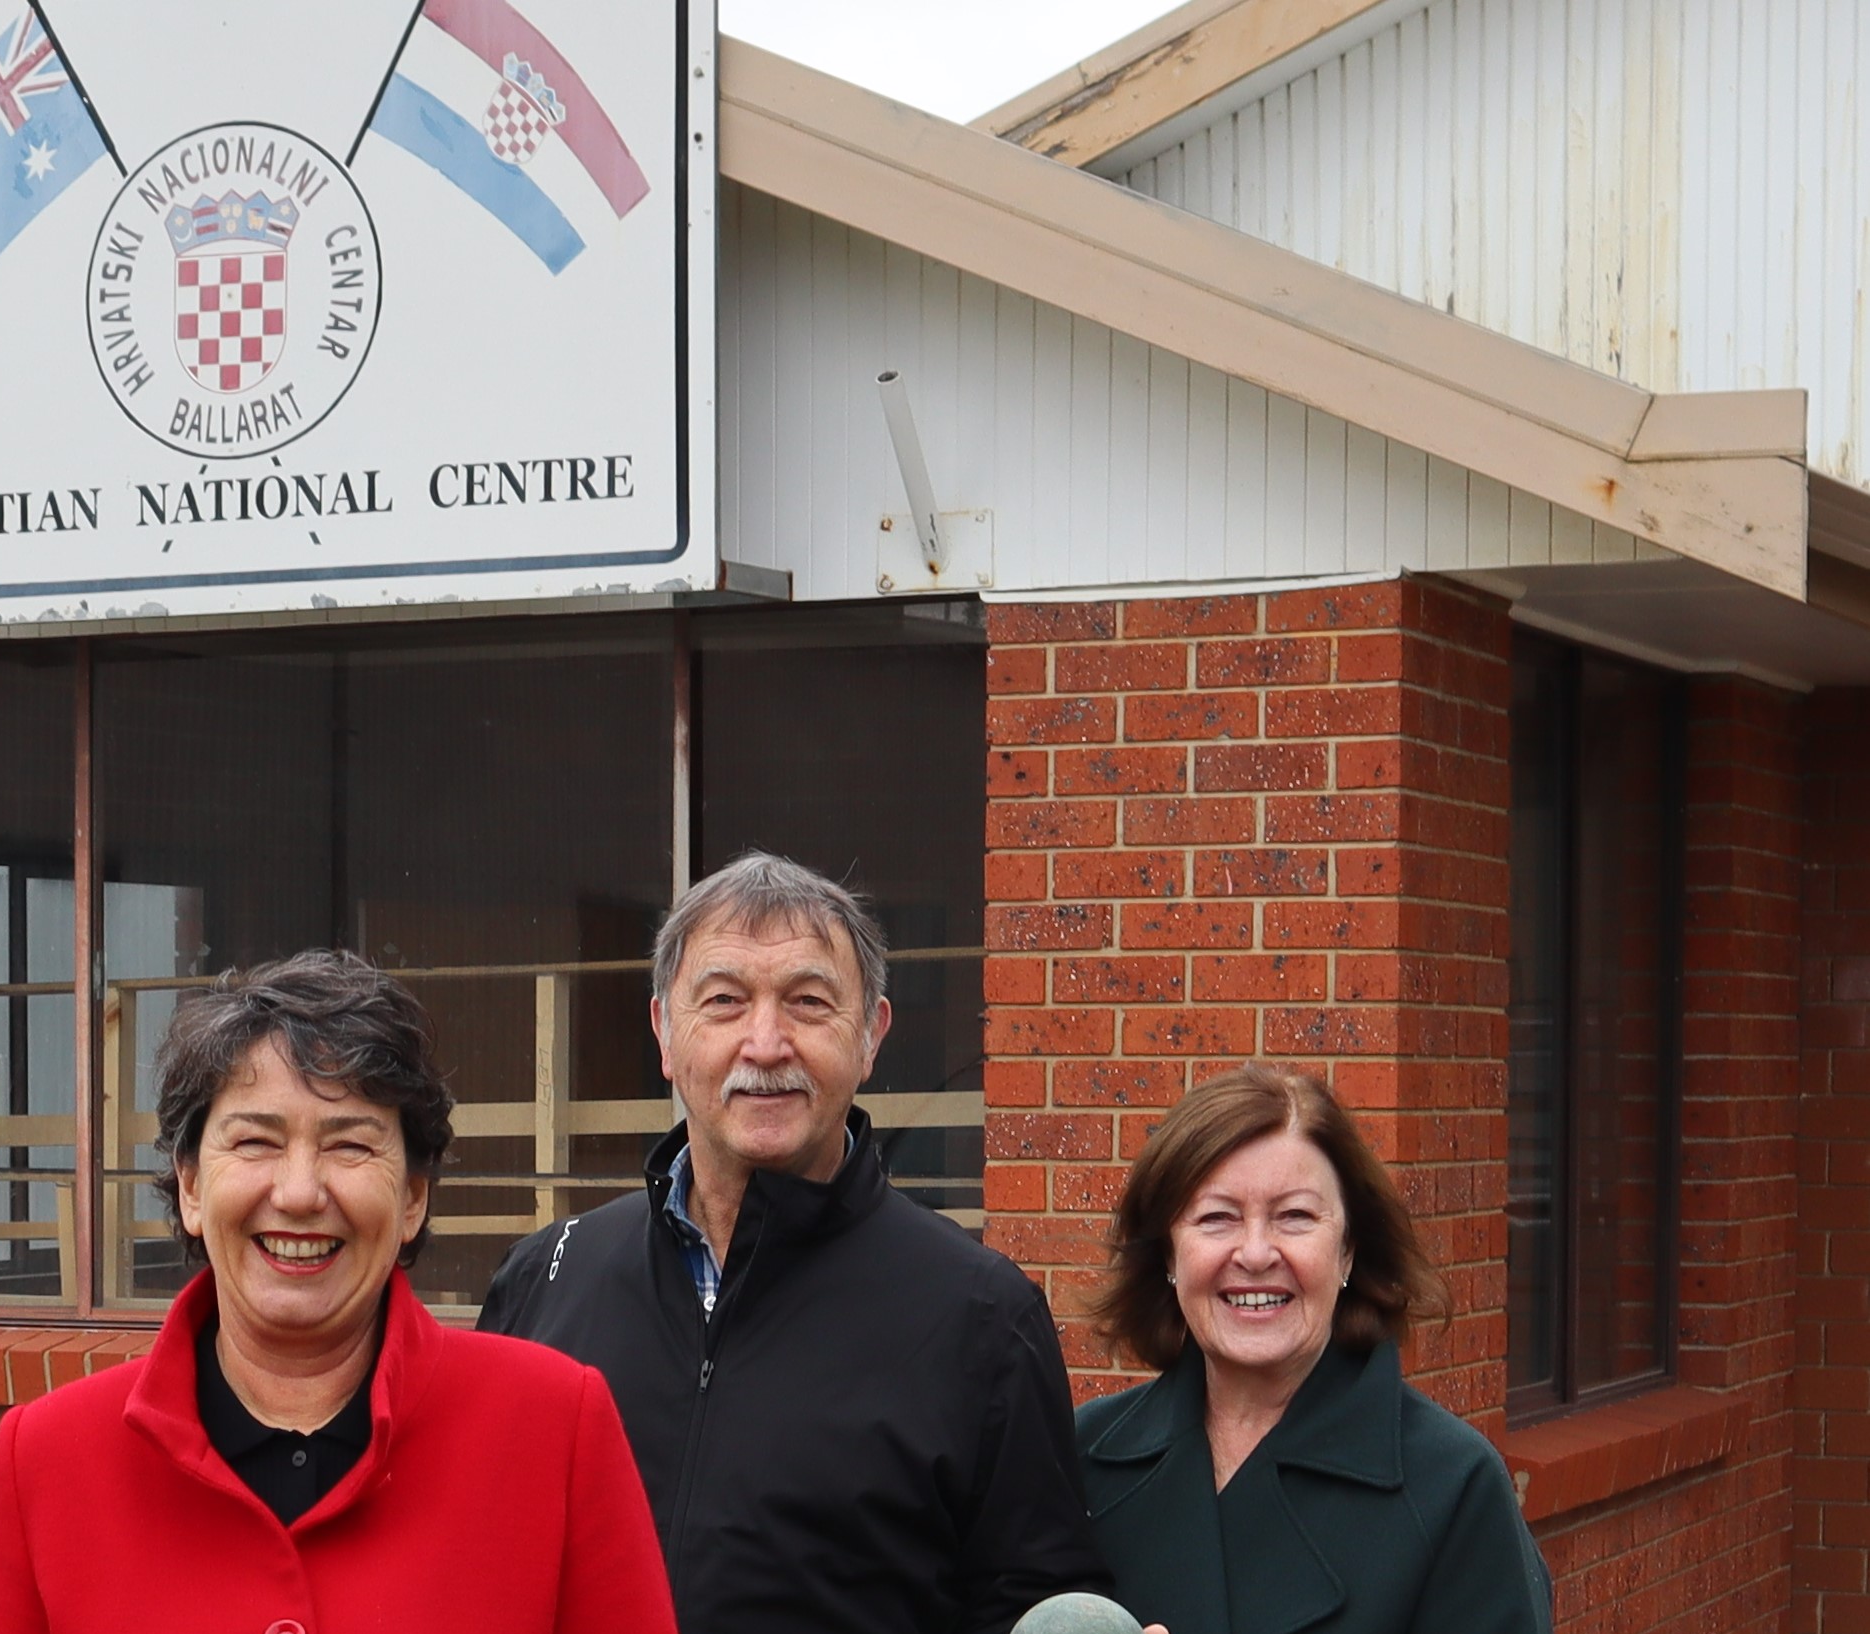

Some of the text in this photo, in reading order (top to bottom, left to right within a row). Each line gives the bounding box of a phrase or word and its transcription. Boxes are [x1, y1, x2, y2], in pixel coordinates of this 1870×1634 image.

[99, 135, 365, 397] HRVATSKI NACIONALNI CENTAR
[168, 382, 303, 445] BALLARAT
[134, 470, 394, 527] NATIONAL
[428, 454, 635, 509] CENTRE
